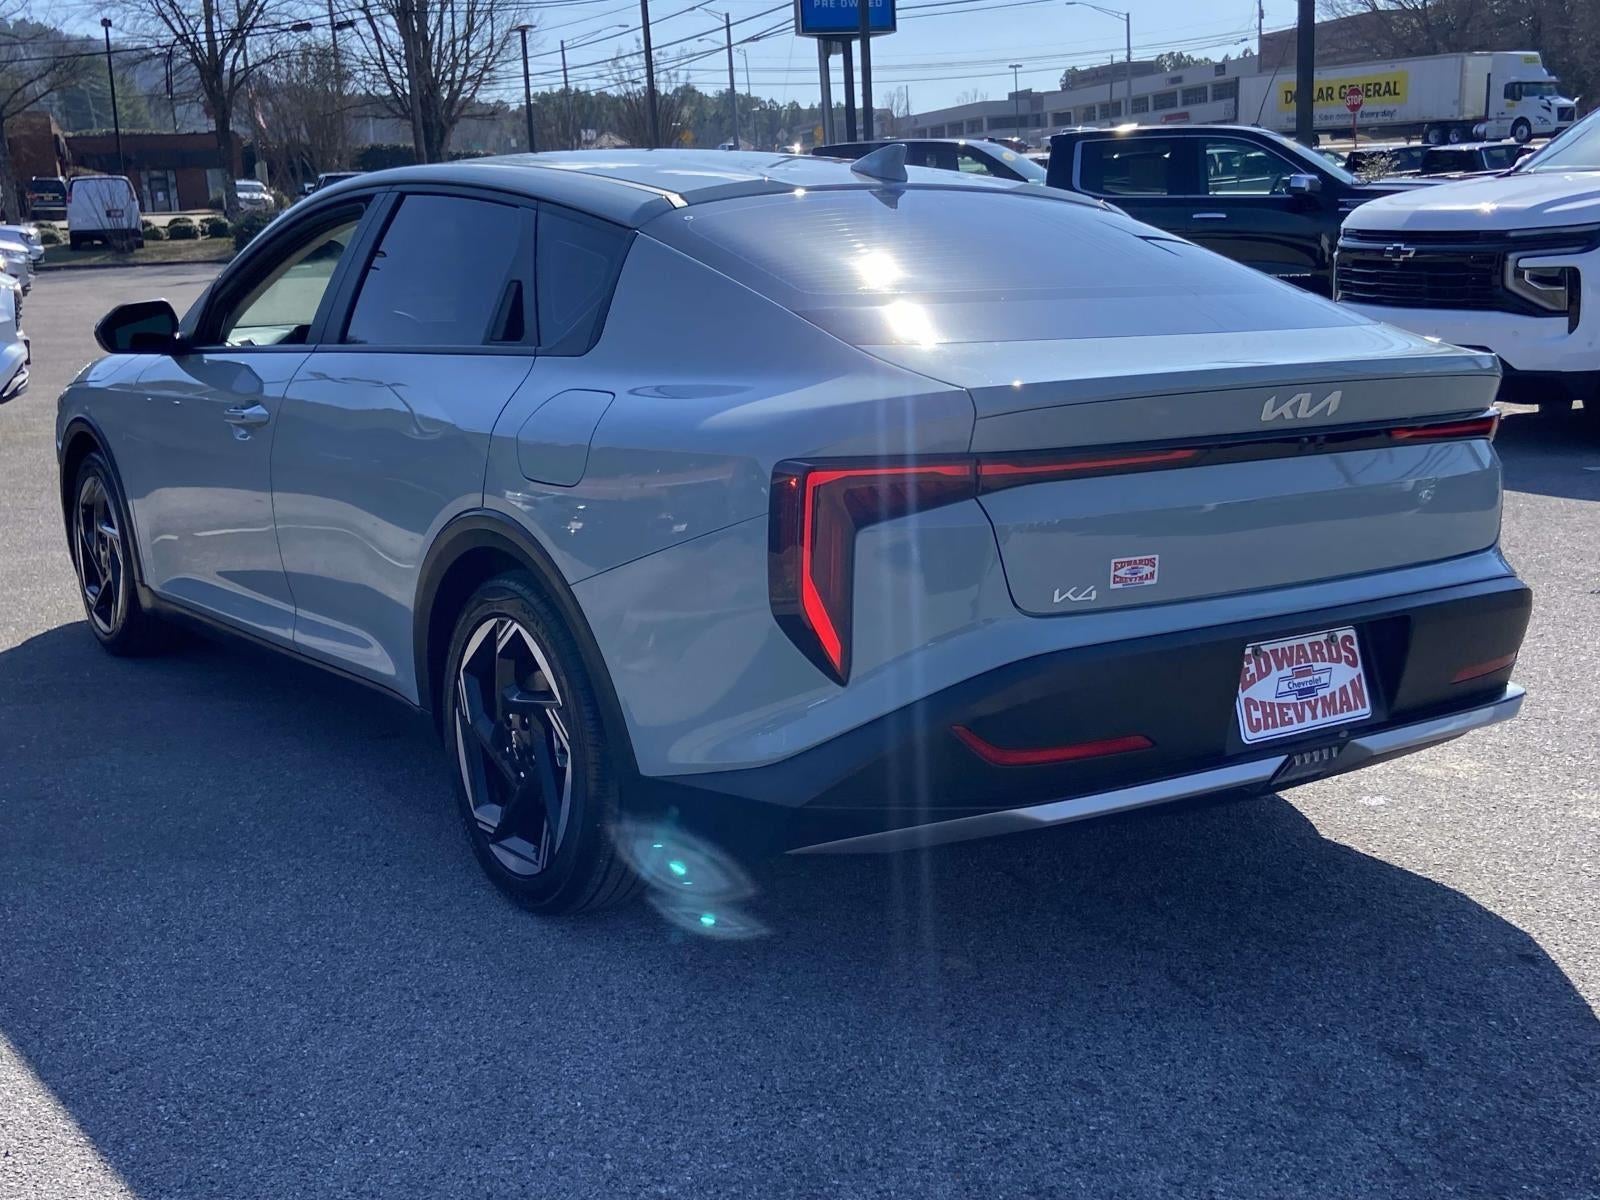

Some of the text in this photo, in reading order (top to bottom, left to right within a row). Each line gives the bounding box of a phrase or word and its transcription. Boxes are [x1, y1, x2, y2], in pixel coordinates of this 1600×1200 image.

[813, 0, 882, 8] PRE-OWED
[1338, 81, 1400, 100] GERAL
[1346, 95, 1363, 106] STOP
[1261, 390, 1342, 421] KIA
[1113, 557, 1156, 573] EDWARDS
[1053, 585, 1097, 603] K4
[1240, 634, 1359, 692] EDWARDS
[1287, 675, 1322, 690] Chevrolet
[1244, 672, 1367, 734] CHEVYMAN
